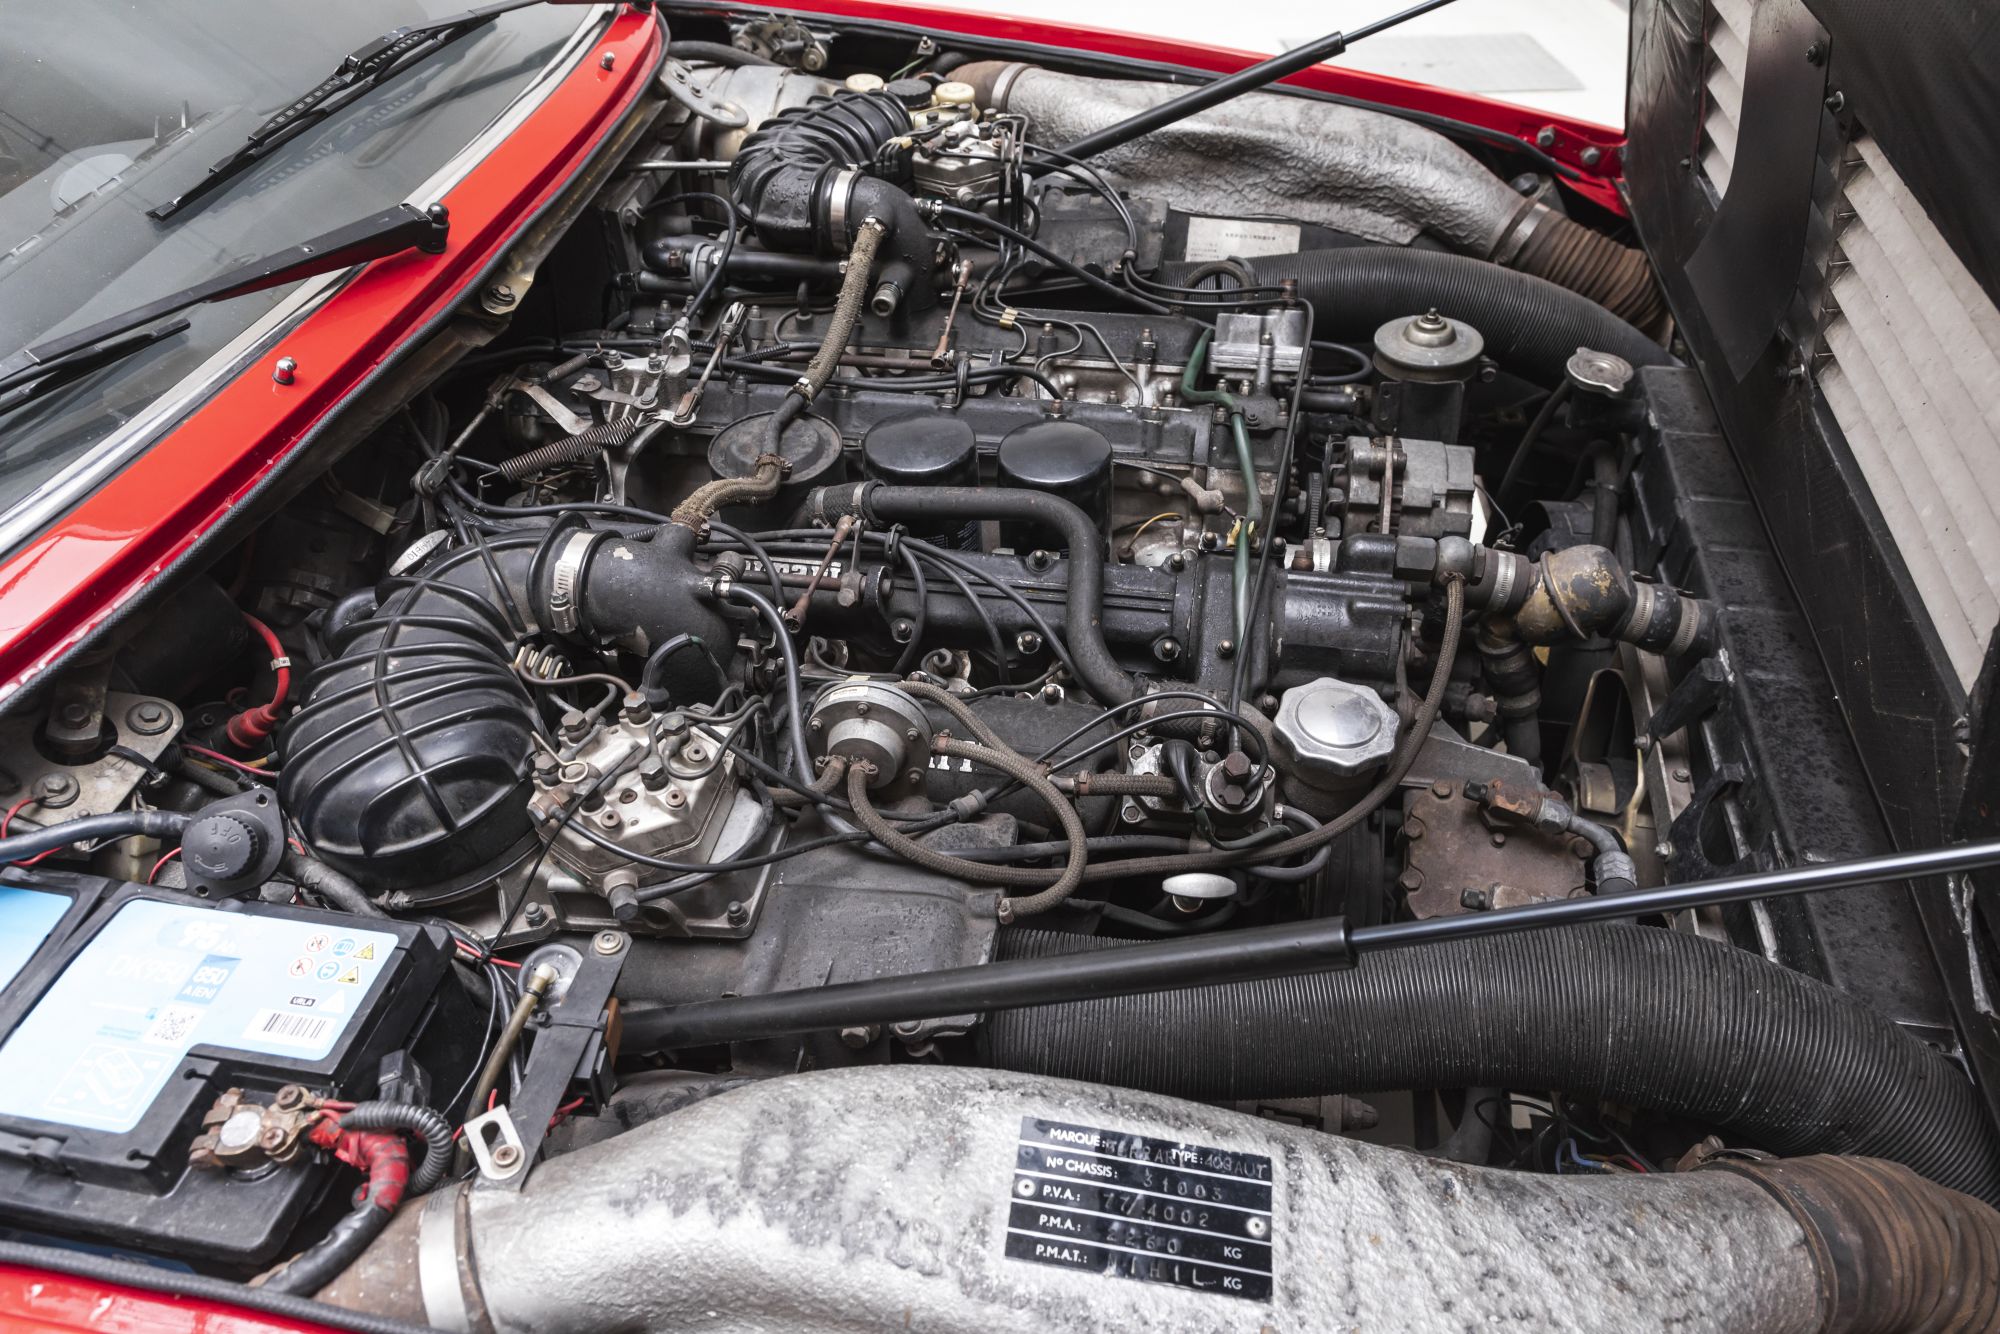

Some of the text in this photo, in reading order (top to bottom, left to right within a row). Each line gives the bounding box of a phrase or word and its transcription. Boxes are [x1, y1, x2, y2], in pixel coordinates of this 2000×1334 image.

[177, 921, 228, 950] 95
[192, 966, 228, 984] 850
[1224, 1246, 1242, 1259] KG
[1223, 1276, 1242, 1290] KG
